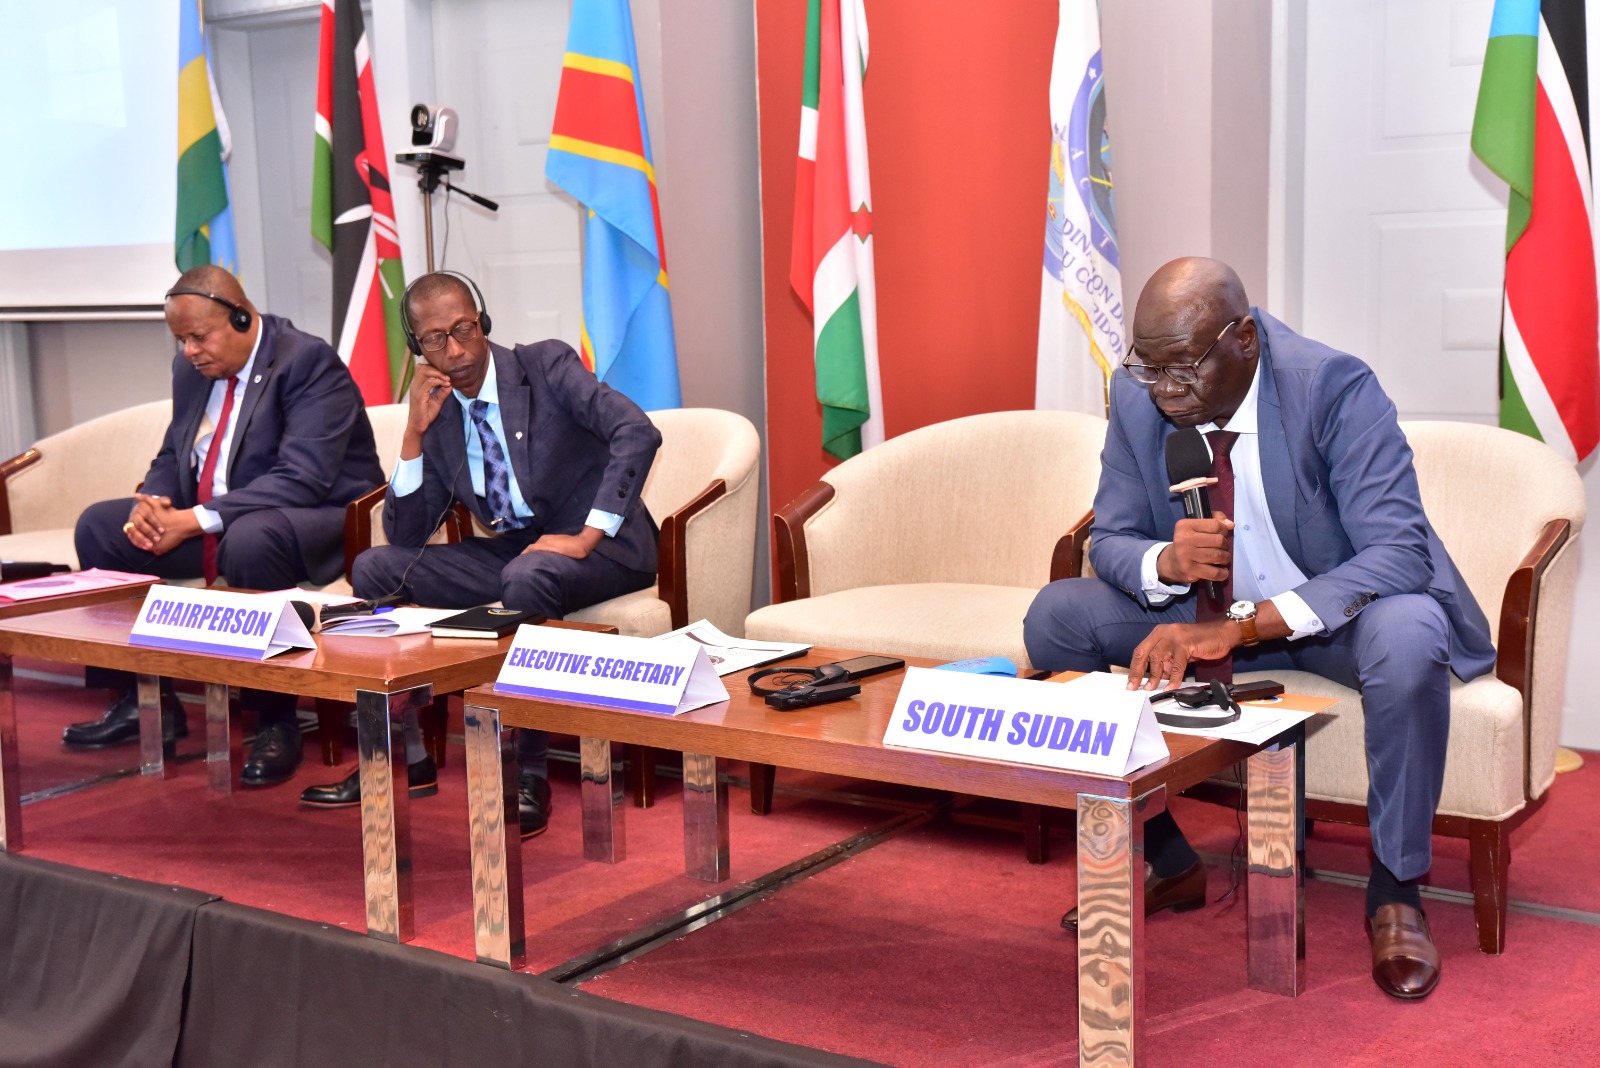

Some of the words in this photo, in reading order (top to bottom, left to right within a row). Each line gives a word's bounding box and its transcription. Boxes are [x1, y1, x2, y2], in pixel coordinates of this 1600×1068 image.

[145, 599, 273, 637] CHAIRPERSON
[508, 647, 592, 675] EXECUTIVE
[591, 656, 686, 686] SECRETARY
[902, 699, 1006, 742] SOUTH
[1006, 711, 1119, 757] SUDAN
